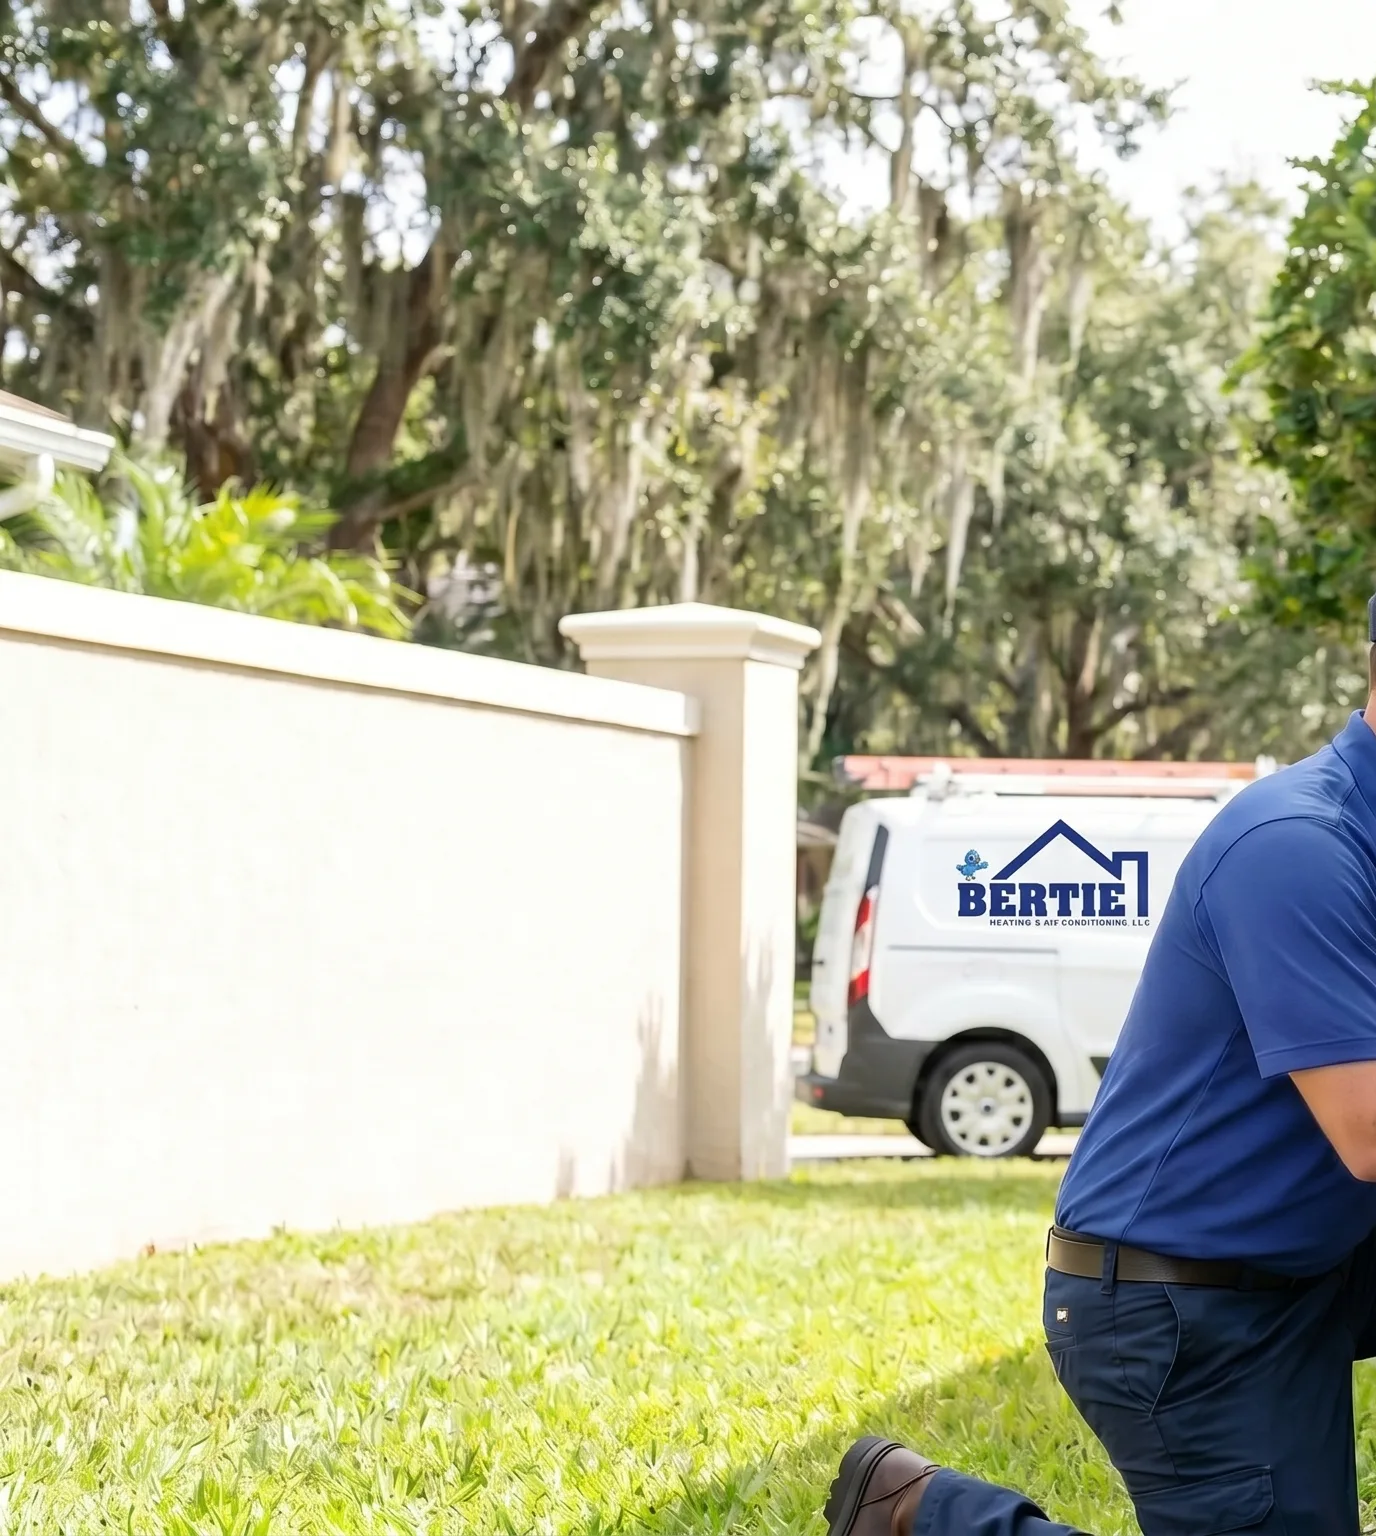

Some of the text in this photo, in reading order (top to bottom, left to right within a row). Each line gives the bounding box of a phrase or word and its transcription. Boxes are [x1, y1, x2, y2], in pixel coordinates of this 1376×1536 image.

[958, 883, 1126, 917] BERTIE
[989, 919, 1032, 927] HEATING
[1132, 919, 1150, 927] LLC
